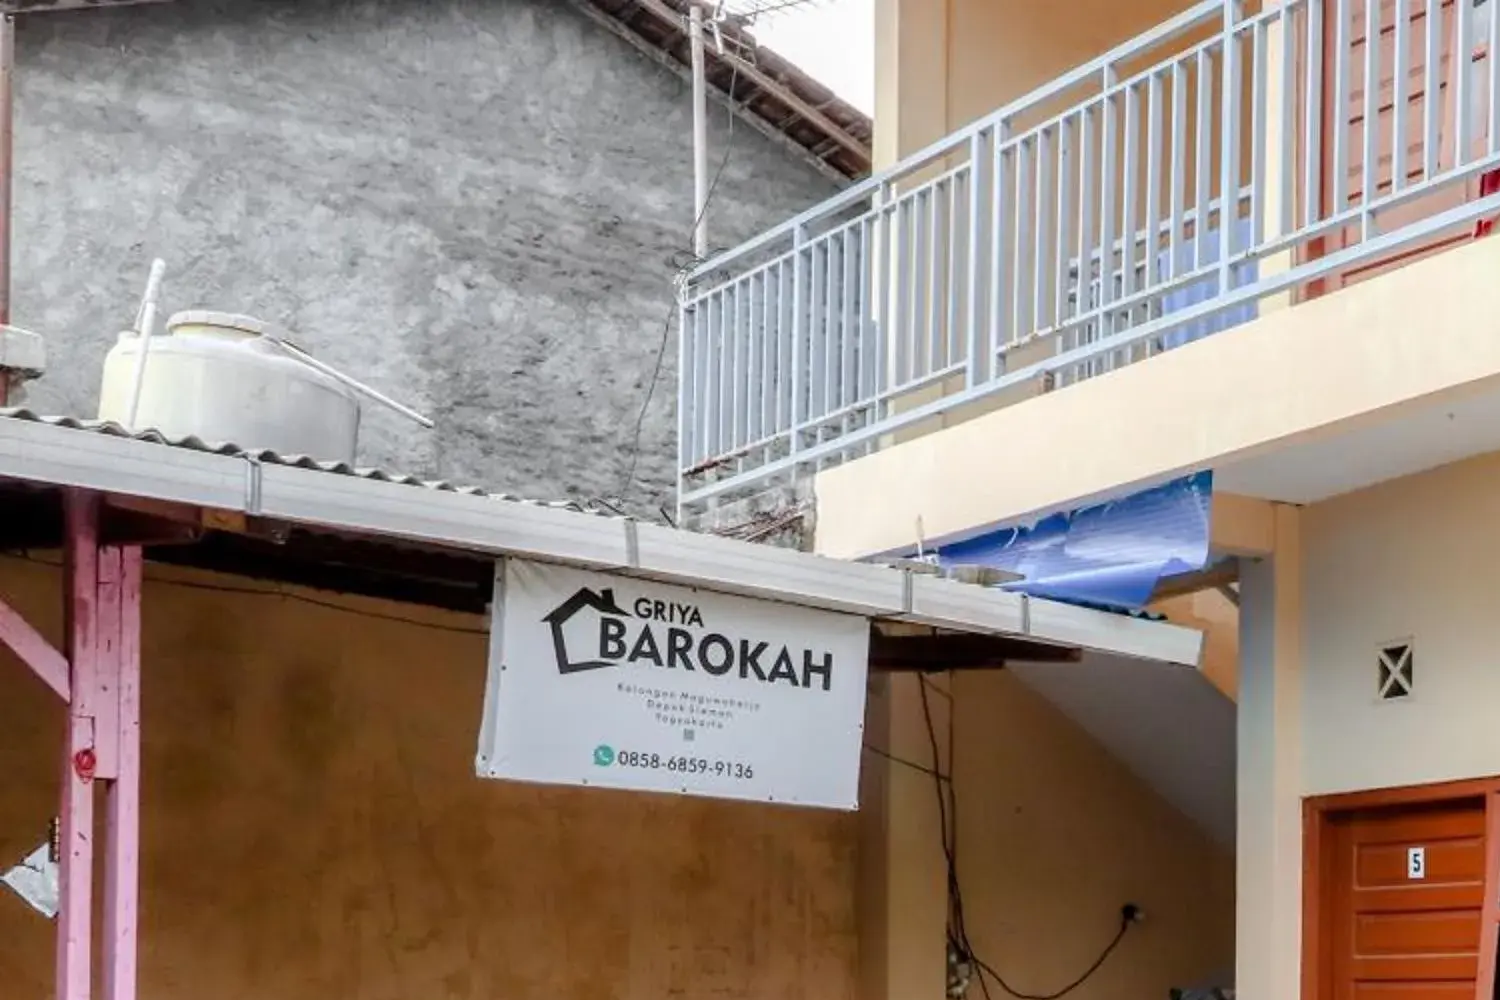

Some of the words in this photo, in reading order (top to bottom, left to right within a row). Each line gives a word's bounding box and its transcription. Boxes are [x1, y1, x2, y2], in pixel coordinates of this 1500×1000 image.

[634, 597, 705, 628] GRIYA
[600, 617, 833, 692] BAROKAH
[617, 750, 753, 780] 0858-6859-9136
[1412, 852, 1421, 872] 5
